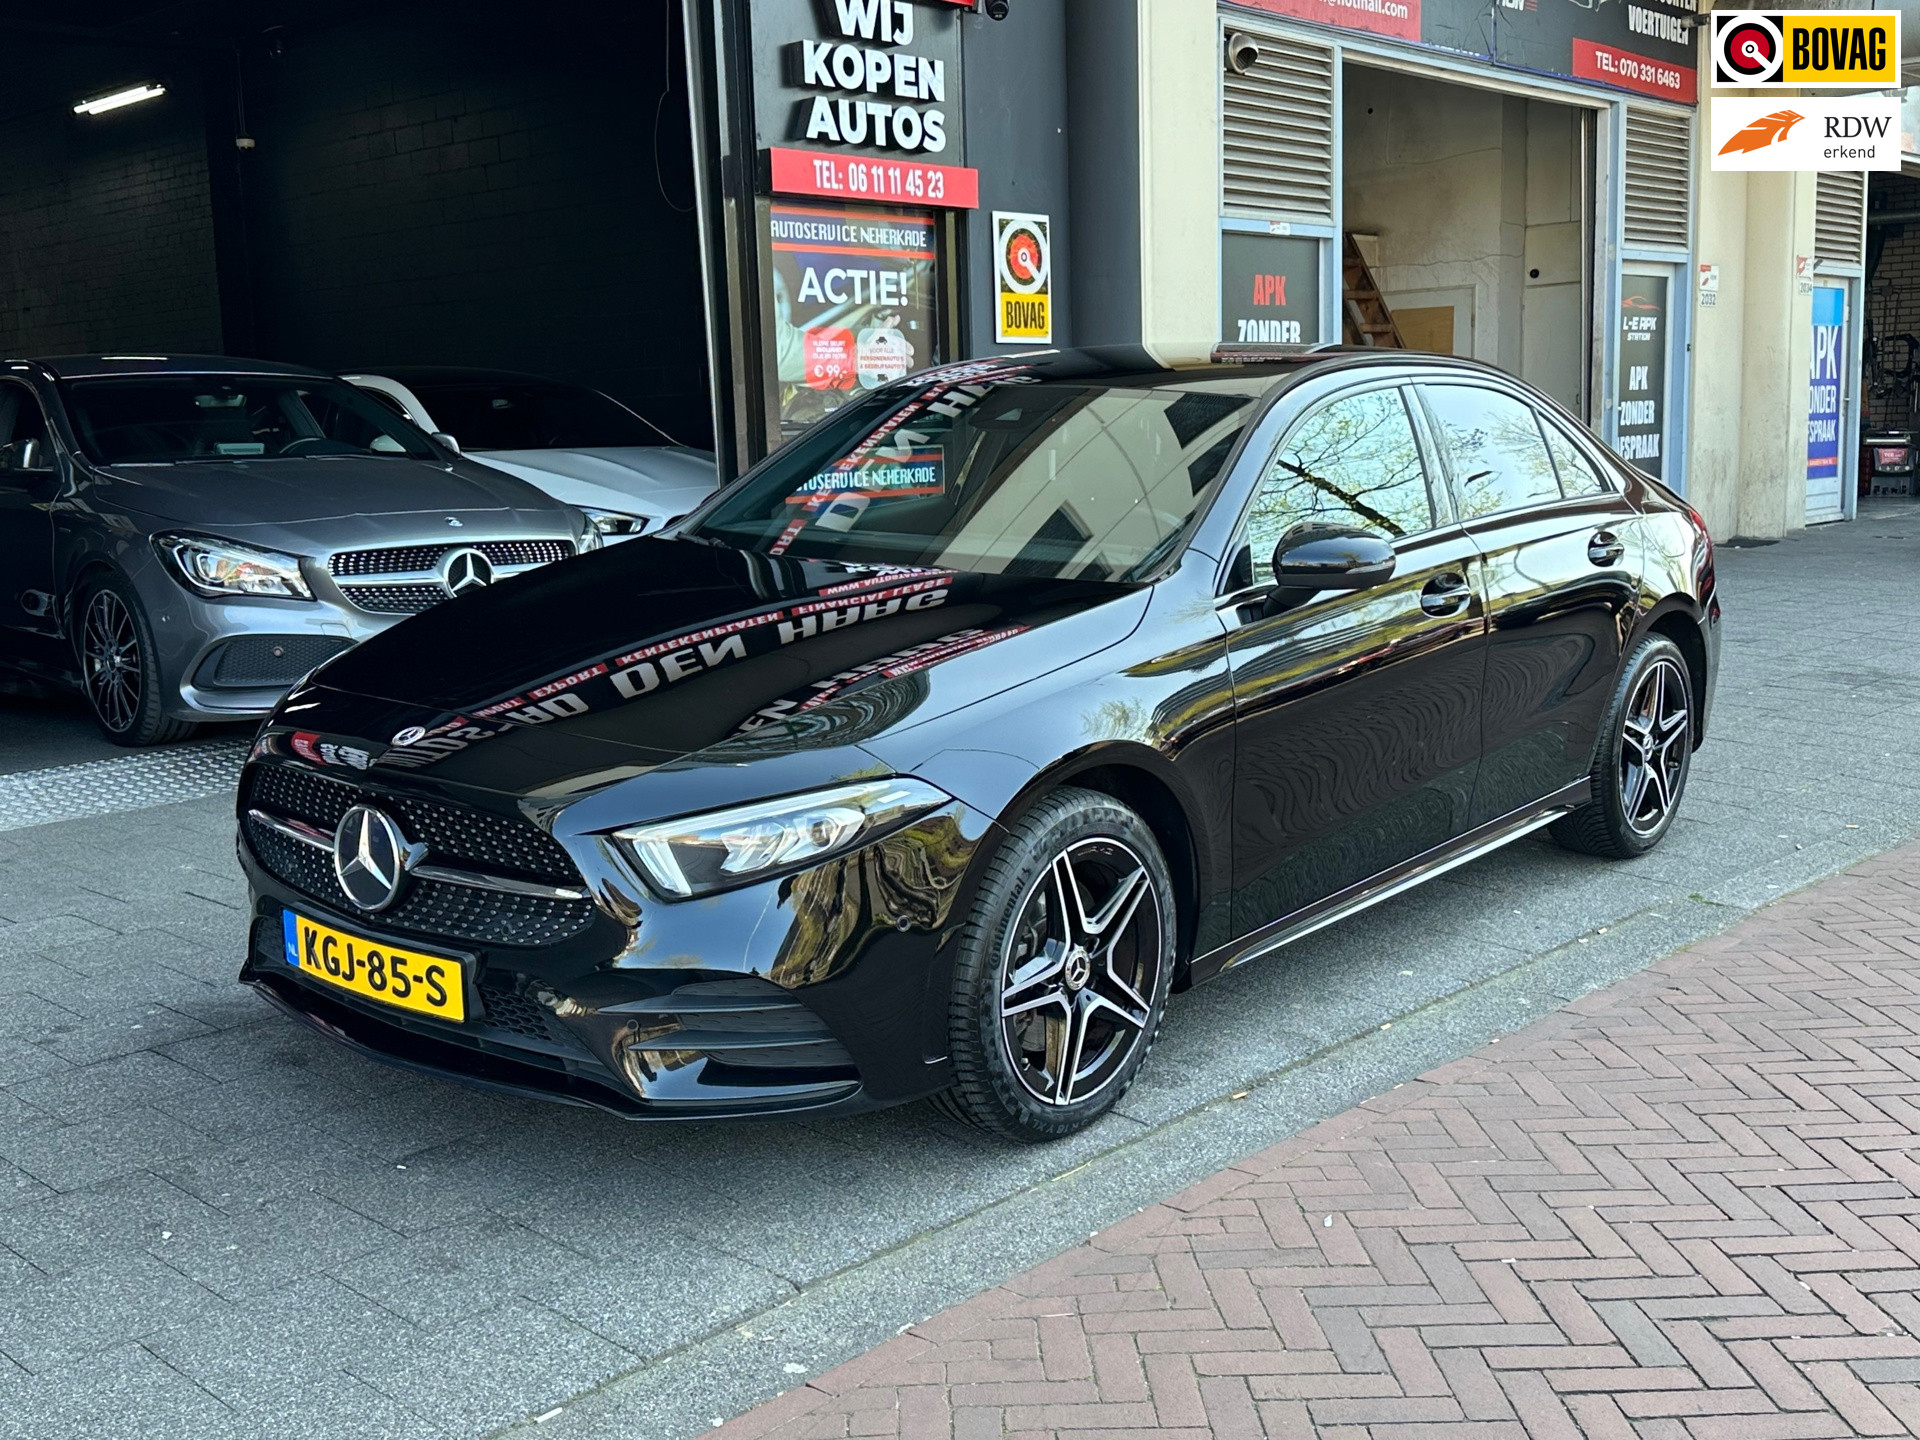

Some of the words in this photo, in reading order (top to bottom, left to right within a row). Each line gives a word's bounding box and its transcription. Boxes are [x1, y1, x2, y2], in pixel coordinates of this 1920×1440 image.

[834, 0, 914, 45] WIJ
[1319, 0, 1408, 19] otmail.com
[1628, 4, 1688, 45] VOERTUIGEN
[803, 39, 945, 101] KOPEN
[1595, 51, 1618, 73] TEL:
[1620, 58, 1638, 79] 070
[1640, 64, 1655, 83] 331
[1657, 68, 1680, 89] 6463
[806, 96, 946, 152] AUTOS
[813, 159, 843, 190] TEL:
[848, 162, 867, 192] 06
[871, 166, 884, 194] 11
[888, 167, 901, 195] 11
[905, 169, 923, 198] 45
[927, 170, 944, 199] 23
[771, 220, 857, 243] AUTOSERVICE
[860, 227, 927, 247] NEHERKADE
[798, 267, 908, 307] ACTIE!
[1253, 274, 1286, 306] APK
[1701, 293, 1716, 305] 2032
[1005, 300, 1045, 330] BOVAG
[1238, 319, 1301, 343] ZONDER
[814, 364, 824, 378] €
[1629, 366, 1648, 390] APK
[1620, 400, 1655, 426] ZONDER
[1809, 385, 1837, 414] ONDER
[1808, 419, 1836, 443] SPRAAK
[796, 471, 869, 492] TOSERVICE
[872, 466, 936, 486] NEHERKADE
[288, 941, 298, 957] NL
[304, 926, 448, 1007] KGJ-85-S
